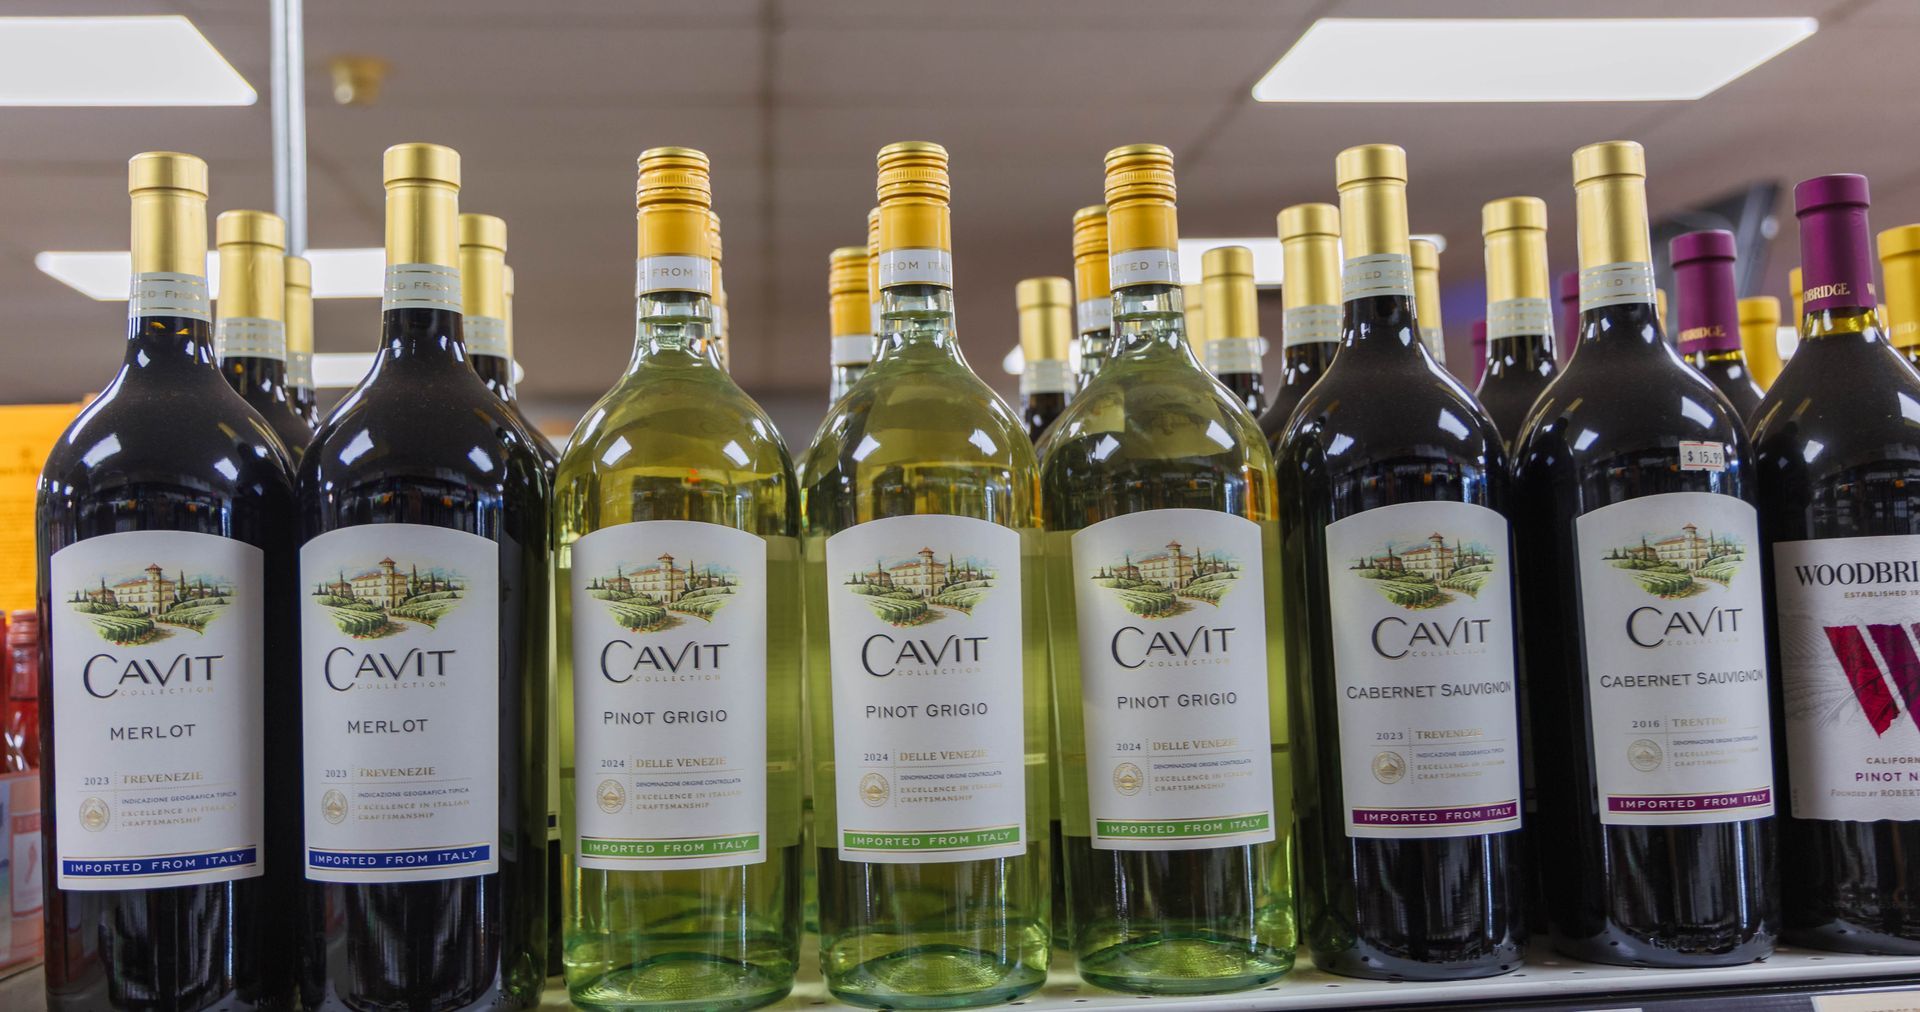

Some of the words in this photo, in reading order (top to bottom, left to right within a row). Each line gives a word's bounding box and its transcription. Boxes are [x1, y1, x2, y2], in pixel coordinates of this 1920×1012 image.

[652, 268, 693, 277] FROM
[1688, 451, 1693, 462] $
[1794, 561, 1920, 586] WOODBRI
[1844, 590, 1906, 598] ESTABLISHED
[1626, 606, 1742, 648] CAVIT
[1372, 617, 1490, 658] CAVIT
[1112, 626, 1236, 668] CAVIT
[601, 640, 730, 683] CAVIT
[862, 634, 988, 677] CAVIT
[83, 653, 224, 698] CAVIT
[325, 647, 456, 691] CAVIT
[358, 681, 446, 689] COLLECTION
[1600, 674, 1691, 688] CABERNET
[1697, 669, 1763, 685] SAUVIGNON
[121, 687, 214, 696] COLLECTION
[1347, 685, 1435, 700] CABERNET
[1441, 681, 1511, 697] SAUVIGNON
[1118, 696, 1169, 709] PINOT
[1178, 692, 1237, 707] GRIGIO
[604, 711, 655, 725] PINOT
[663, 710, 727, 724] GRIGIO
[866, 705, 918, 719] PINOT
[926, 703, 988, 717] GRIGIO
[348, 719, 428, 734] MERLOT
[1632, 720, 1660, 728] 2016
[111, 724, 196, 740] MERLOT
[1117, 743, 1141, 751] 2024
[1153, 741, 1189, 750] DELLE
[601, 759, 624, 768] 2024
[636, 759, 673, 768] DELLE
[677, 757, 726, 767] VENEZIE
[864, 753, 888, 761] 2024
[900, 752, 937, 761] DELLE
[123, 771, 203, 784] TREVENEZIE
[326, 770, 347, 778] 2023
[360, 767, 436, 777] TREVENEZIE
[1155, 774, 1209, 782] EXCELLENCE
[1856, 773, 1902, 781] PINOT
[85, 777, 110, 785] 2023
[1620, 800, 1696, 809] IMPORTED
[1704, 797, 1737, 806] FROM
[1743, 793, 1766, 804] ITALY
[1364, 813, 1438, 822] IMPORTED
[1446, 811, 1481, 820] FROM
[1487, 806, 1512, 817] ITALY
[1106, 825, 1175, 834] IMPORTED
[1184, 823, 1223, 832] FROM
[1230, 818, 1260, 829] ITALY
[852, 837, 920, 846] IMPORTED
[929, 835, 969, 845] FROM
[977, 831, 1010, 841] ITALY
[589, 843, 655, 853] IMPORTED
[664, 843, 704, 853] FROM
[713, 840, 749, 850] ITALY
[71, 863, 141, 872] IMPORTED
[152, 860, 196, 870] FROM
[205, 853, 245, 865] ITALY
[315, 855, 376, 865] IMPORTED
[386, 855, 428, 865] FROM
[438, 851, 478, 861] ITALY
